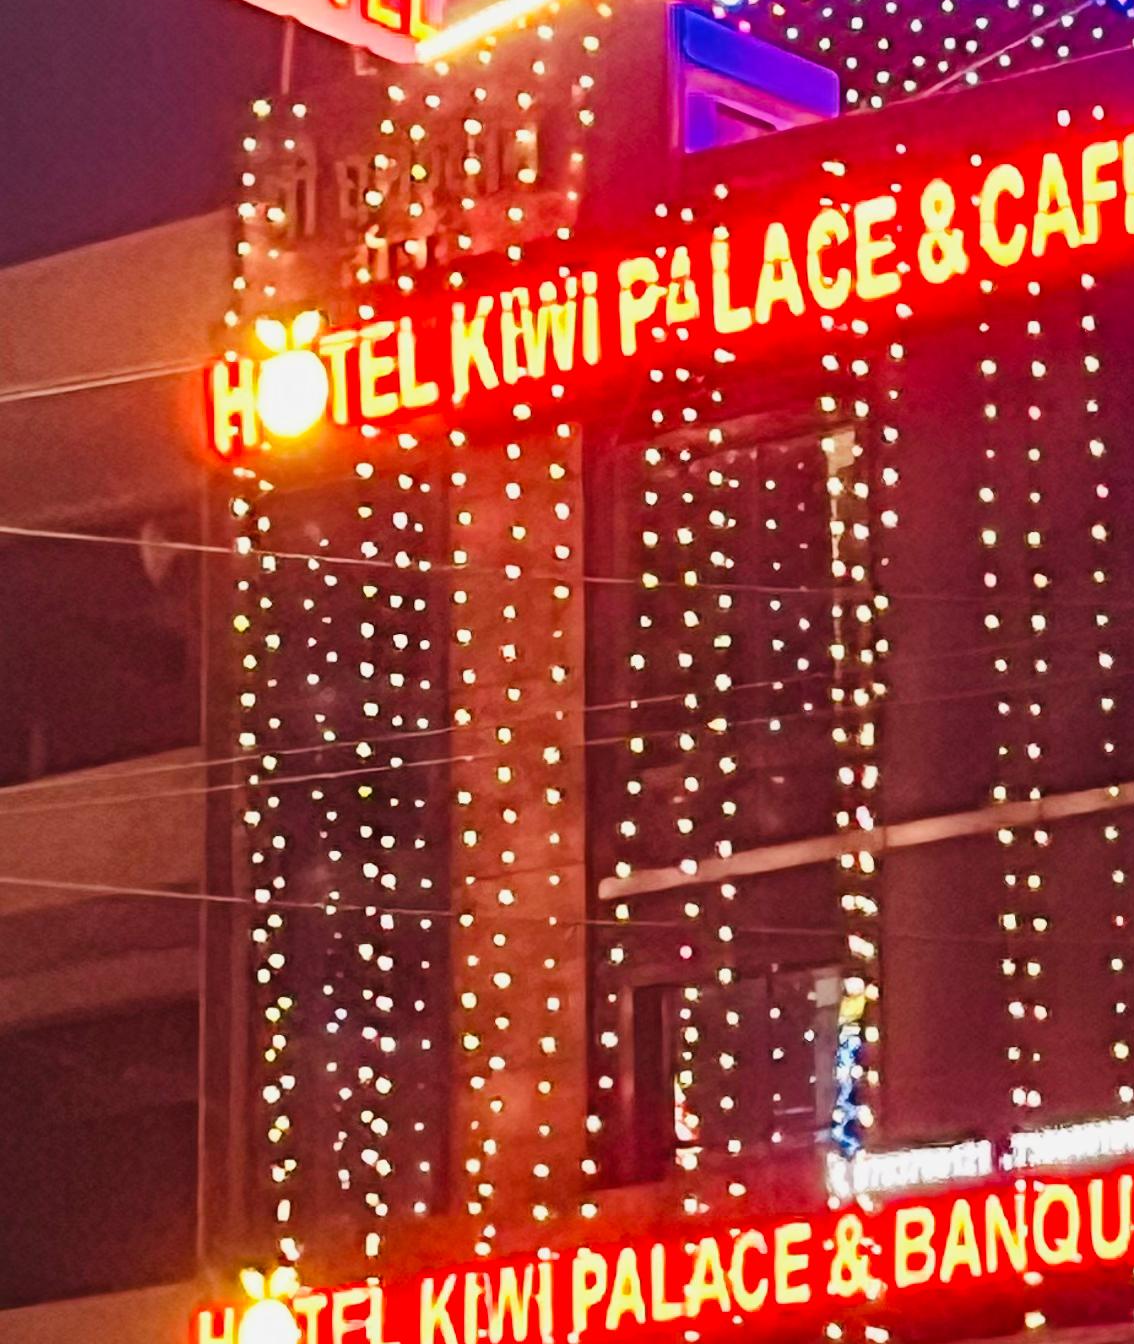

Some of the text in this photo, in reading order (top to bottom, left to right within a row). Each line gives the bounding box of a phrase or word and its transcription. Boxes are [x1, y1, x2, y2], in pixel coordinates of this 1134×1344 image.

[213, 311, 439, 453] HOTEL
[451, 270, 600, 400] KIWI
[618, 197, 901, 358] PALACE
[916, 177, 967, 286] &
[571, 1221, 810, 1331] PALACE
[826, 1212, 869, 1297] &
